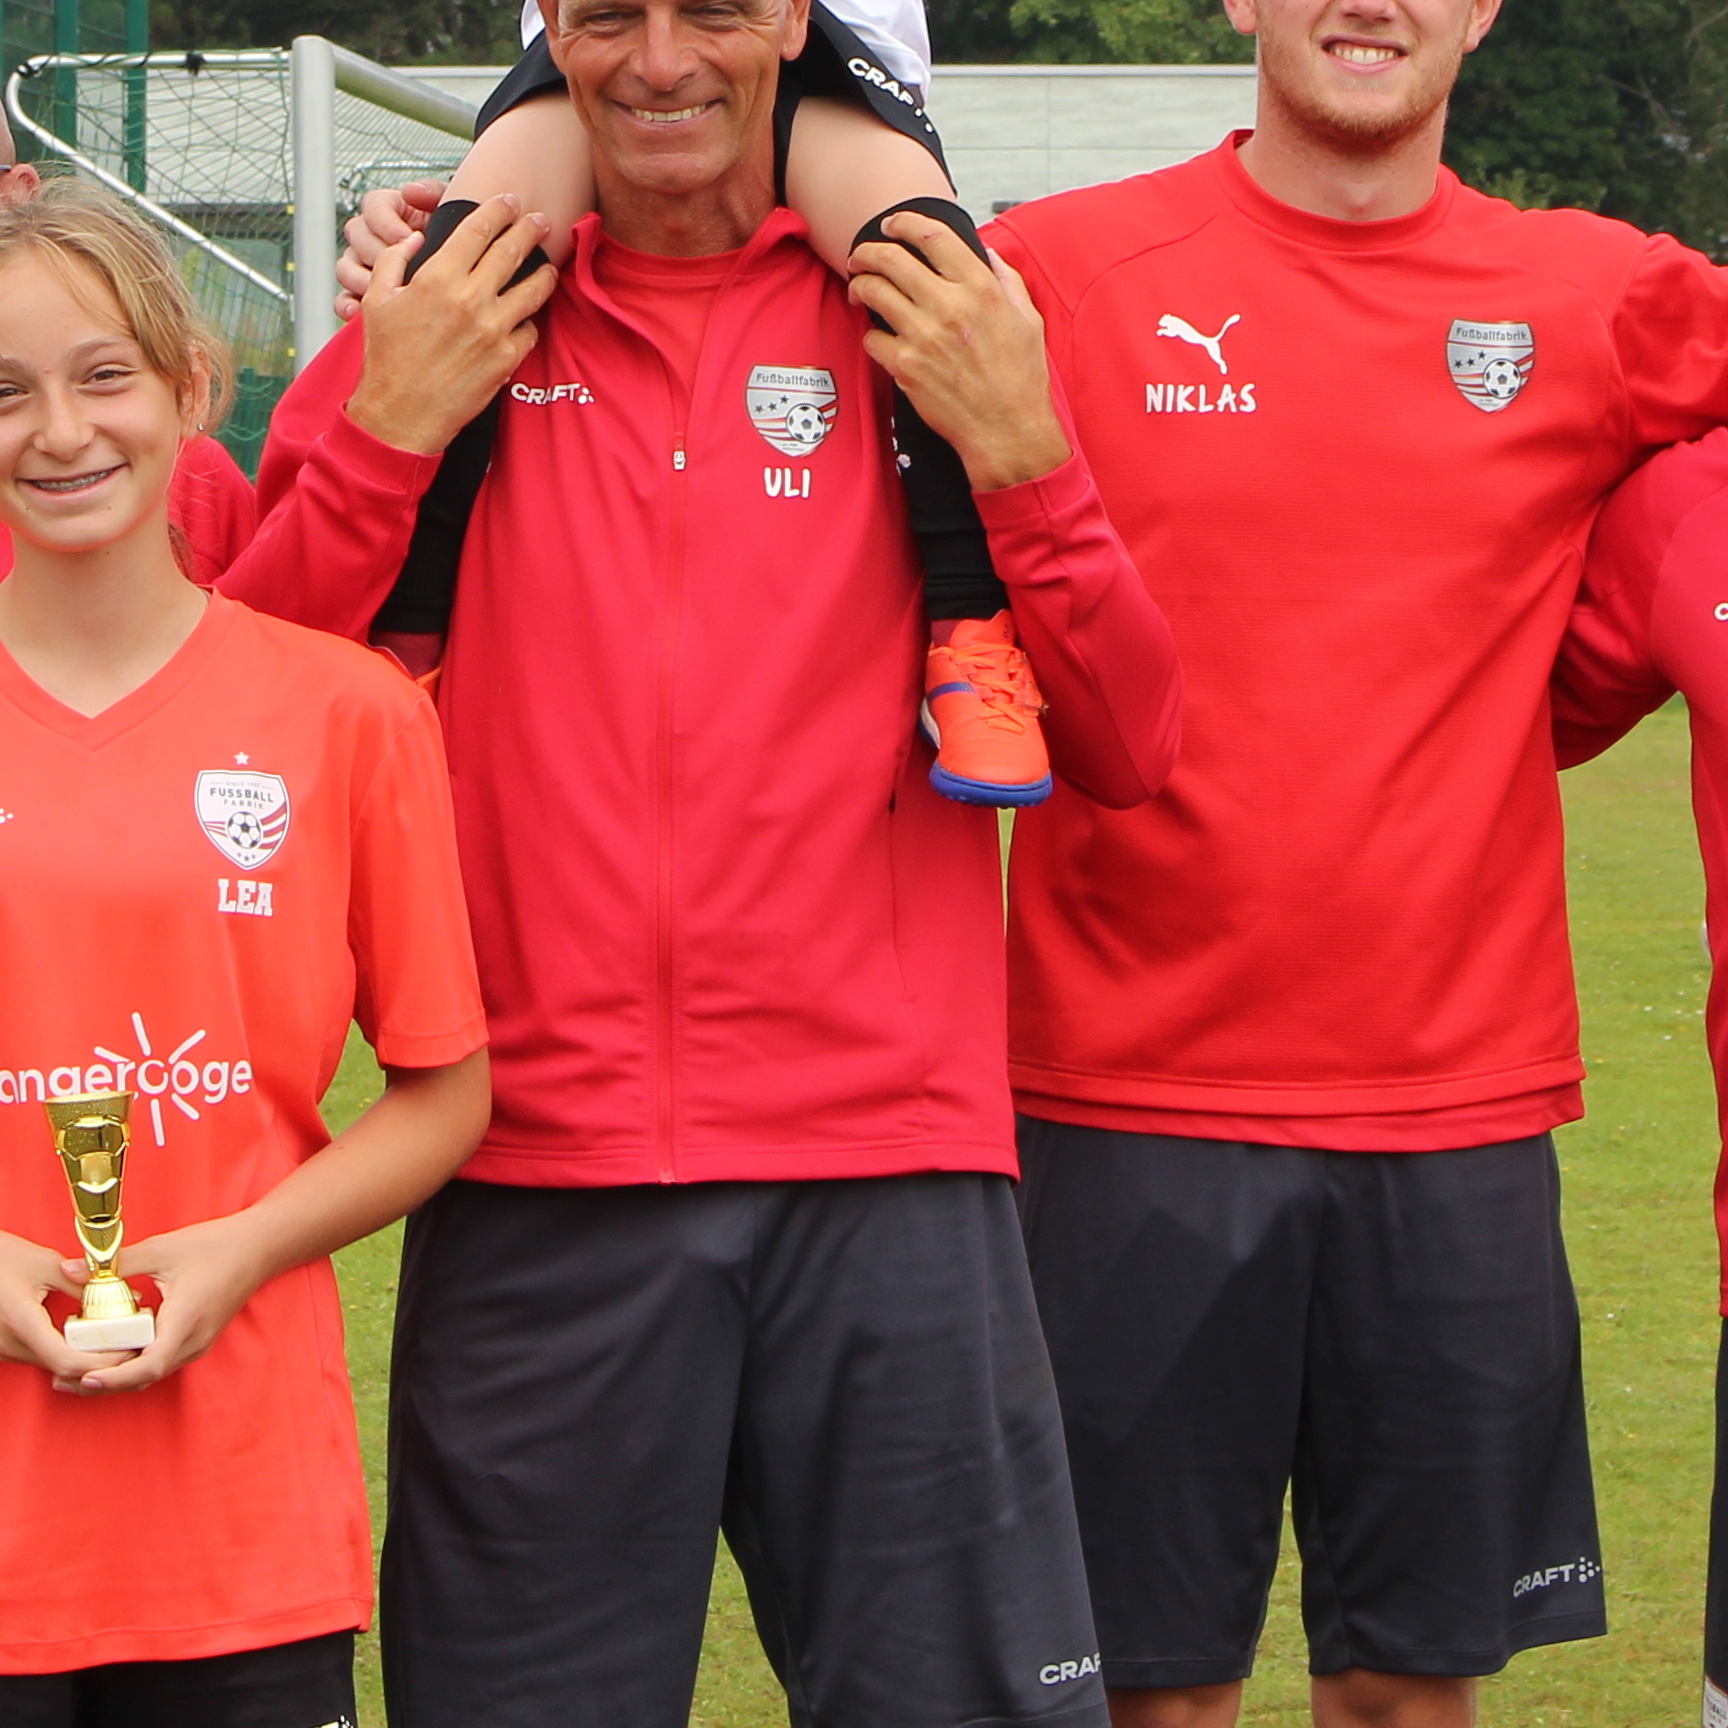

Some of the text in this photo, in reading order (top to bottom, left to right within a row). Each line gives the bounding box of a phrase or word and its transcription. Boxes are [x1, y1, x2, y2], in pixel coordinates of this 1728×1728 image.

[847, 57, 915, 106] CRAF
[1456, 327, 1528, 342] Fußballfabrik
[510, 382, 581, 405] CRAFT
[756, 373, 830, 388] Fußballfabrik
[1145, 383, 1257, 413] NIKLAS
[763, 466, 812, 499] ULI
[209, 787, 274, 803] FUSSBALL
[224, 798, 264, 810] FABRIK
[217, 878, 274, 917] LEA
[1513, 1563, 1576, 1598] CRAFT
[1039, 1652, 1102, 1685] CRAF
